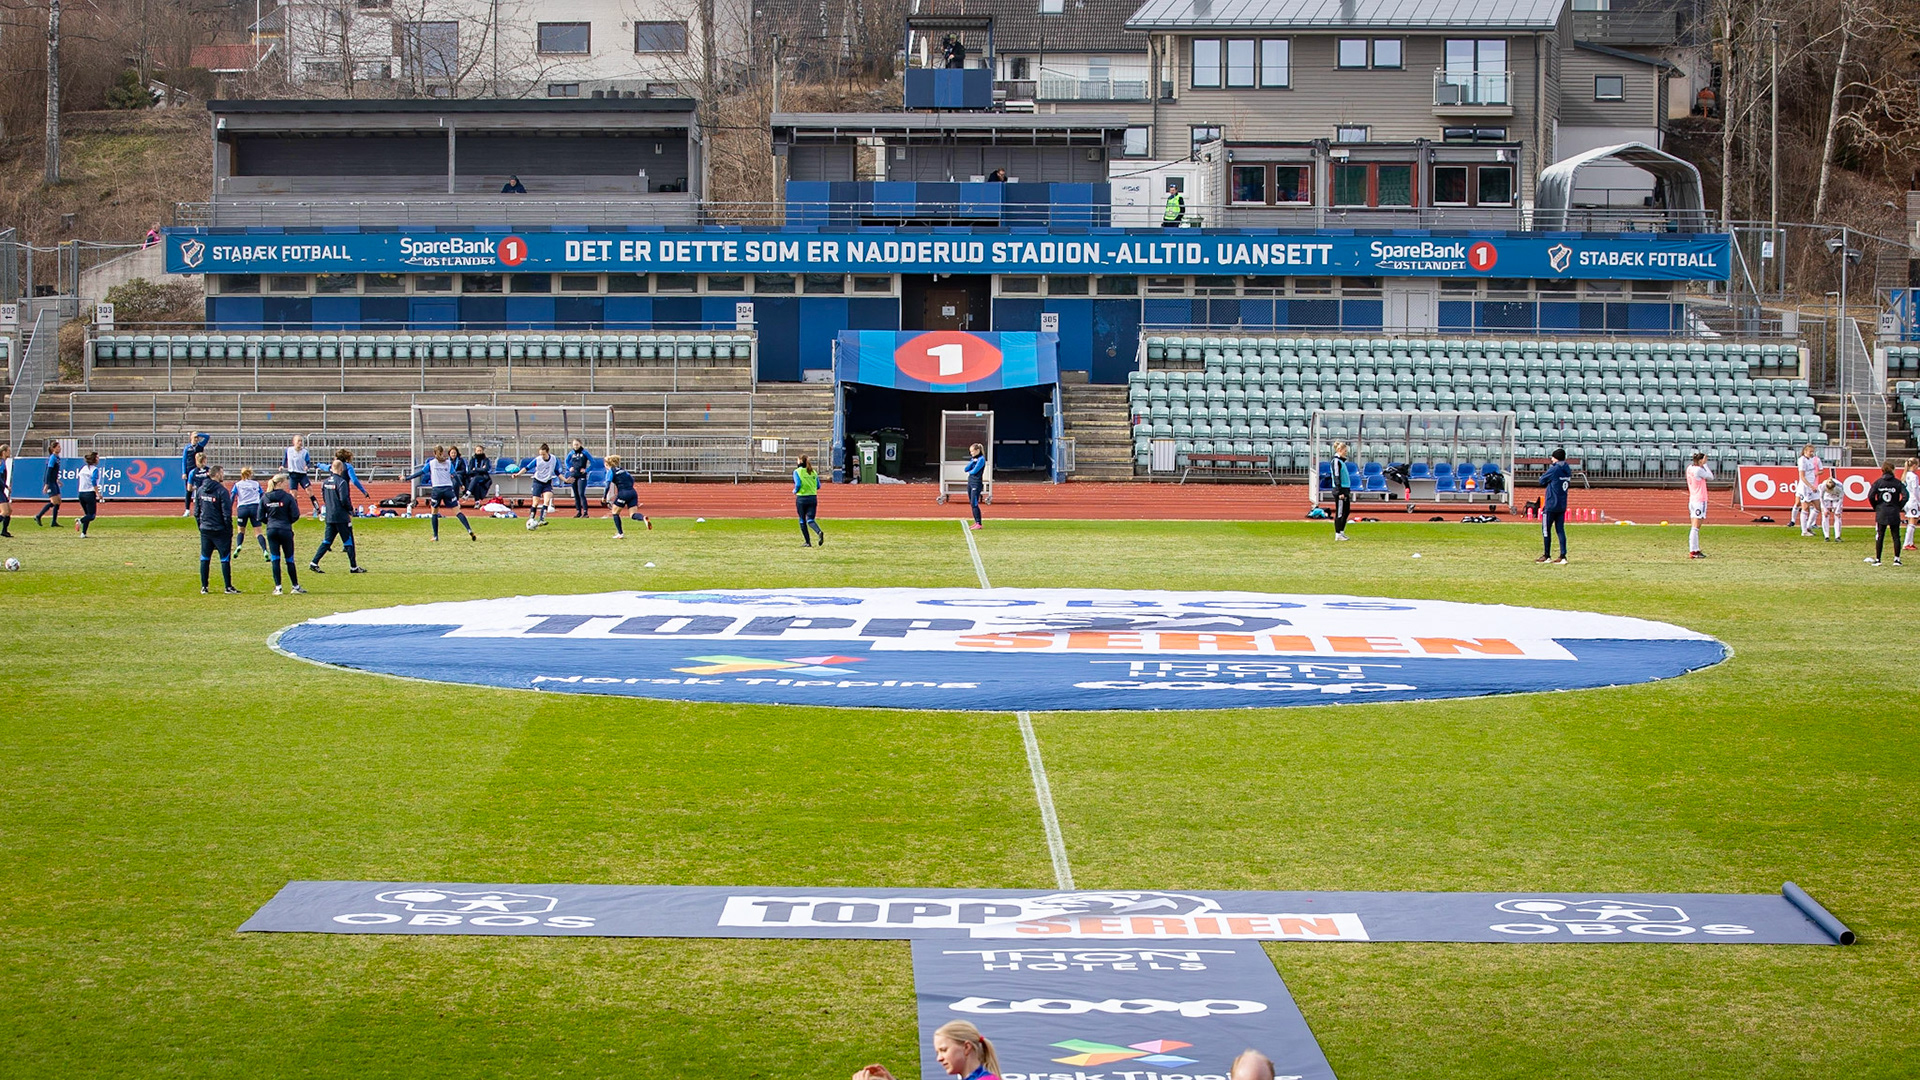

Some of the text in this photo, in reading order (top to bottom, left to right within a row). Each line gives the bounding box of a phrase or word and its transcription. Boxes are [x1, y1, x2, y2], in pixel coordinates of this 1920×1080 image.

[213, 245, 278, 260] STABÆK
[282, 245, 351, 260] FOTBALL
[400, 237, 517, 261] SpareBank 1
[565, 241, 612, 262] DET
[620, 241, 651, 262] ER
[659, 241, 738, 262] DETTE
[745, 241, 799, 262] SOM
[807, 241, 839, 262] ER
[847, 242, 984, 263] NADDERUD
[992, 242, 1100, 263] STADION
[1217, 243, 1333, 264] UANSETT
[1370, 241, 1488, 266] SpareBank 1
[1579, 251, 1645, 266] STABÆK
[1648, 252, 1717, 267] FOTBALL
[1, 307, 16, 315] 302
[98, 306, 113, 314] 303
[737, 306, 752, 314] 304
[1042, 315, 1058, 323] 305
[927, 343, 963, 376] 1
[916, 599, 1417, 611] OBOS
[523, 614, 976, 639] TOPP
[954, 631, 1526, 655] SERIEN
[1130, 661, 1362, 674] THON
[531, 675, 981, 689] Norsk Tipping
[1129, 671, 1366, 680] HOTELS
[1073, 680, 1418, 694] coop
[752, 901, 1022, 924] TOPP
[333, 913, 597, 929] OBOS
[1015, 916, 1341, 936] SERIEN
[1489, 923, 1755, 936] OBOS
[981, 949, 1201, 962] THON
[983, 962, 1208, 972] HOTELS
[948, 997, 1268, 1018] coop
